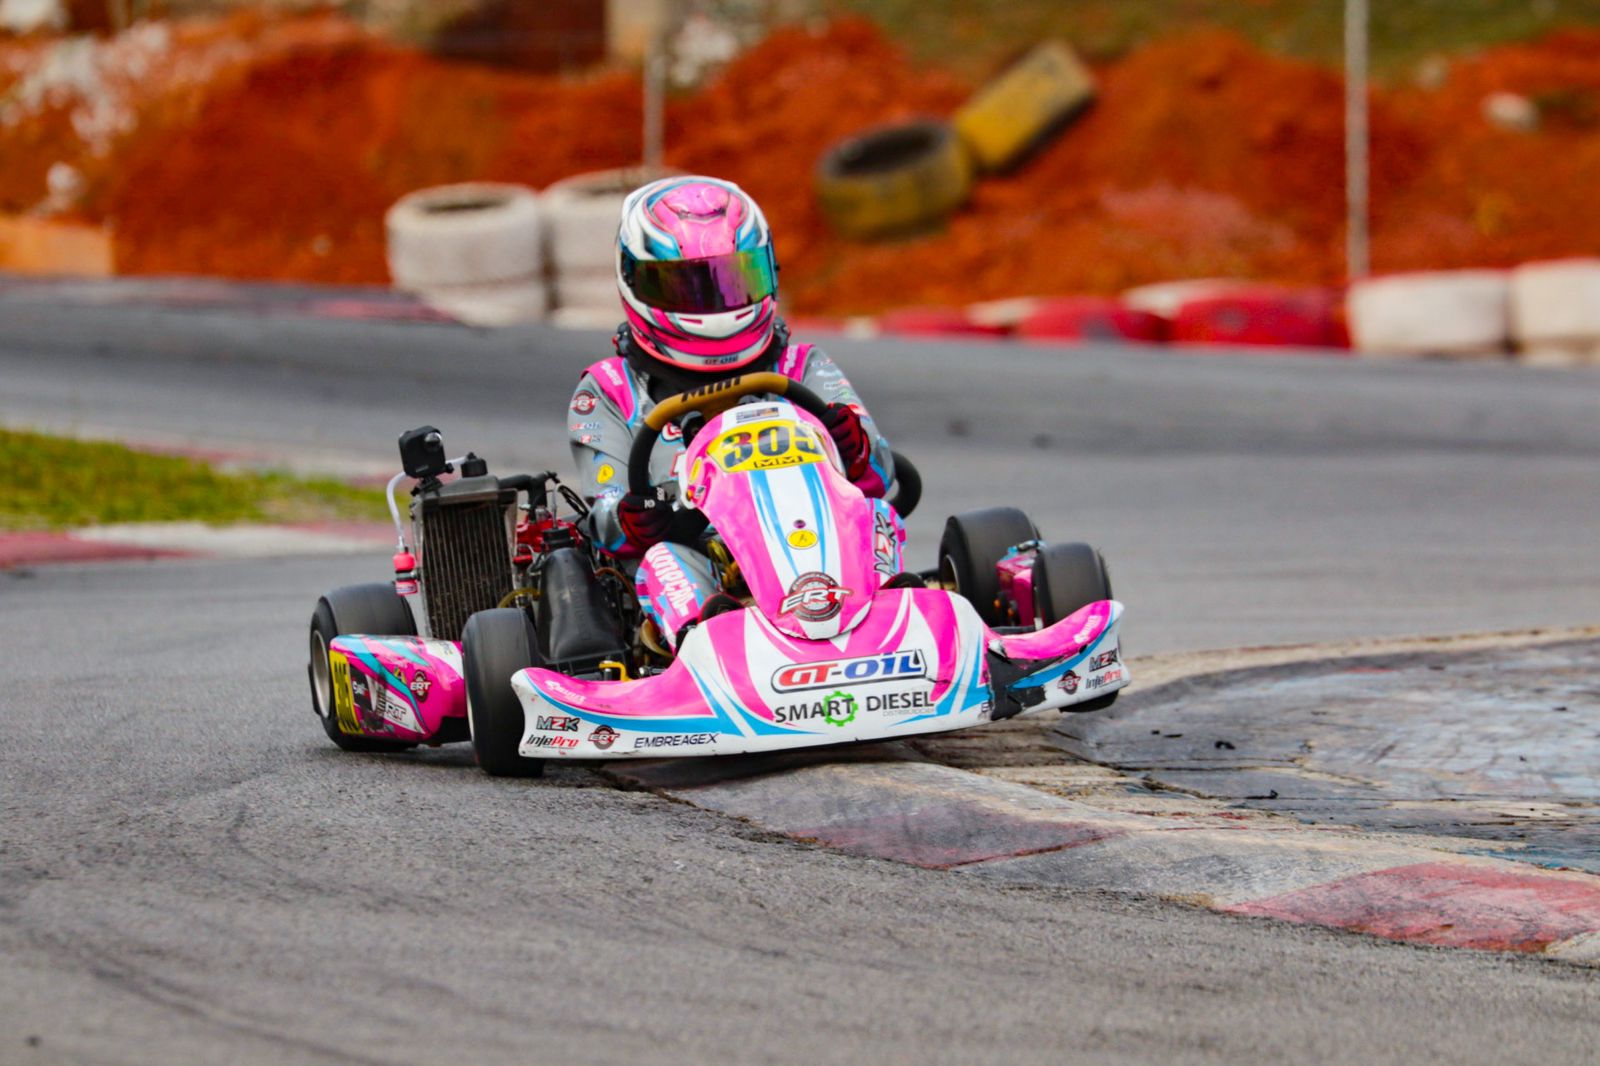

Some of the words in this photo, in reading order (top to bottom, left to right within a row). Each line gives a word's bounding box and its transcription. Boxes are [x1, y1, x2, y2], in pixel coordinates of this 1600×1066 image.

[722, 425, 824, 468] 305
[778, 586, 852, 617] ERT
[779, 652, 922, 687] GT-OIL
[410, 681, 431, 691] ERT
[775, 698, 855, 723] SMART
[866, 691, 935, 712] DIESEL
[536, 715, 580, 732] MZK
[634, 732, 721, 748] EMBREAGEX
